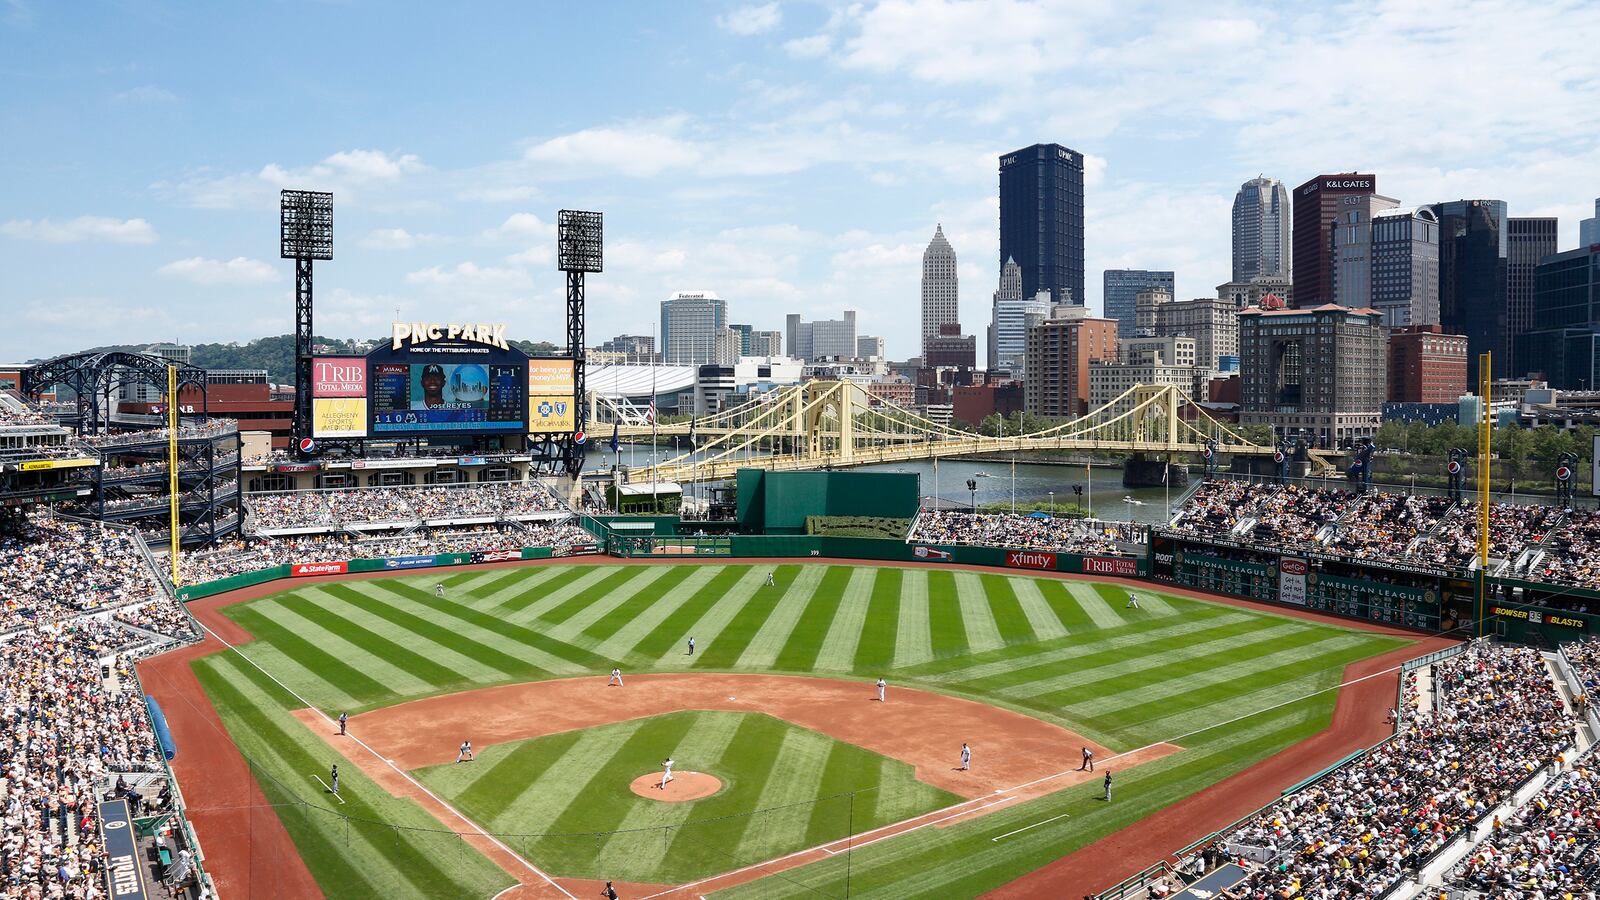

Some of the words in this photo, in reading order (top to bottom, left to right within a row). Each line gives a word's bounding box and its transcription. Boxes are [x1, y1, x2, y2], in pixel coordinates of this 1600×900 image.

[1058, 149, 1073, 162] UPMC
[1326, 180, 1341, 188] K&L
[1342, 180, 1370, 188] GATES
[392, 321, 442, 351] PNC
[446, 322, 510, 351] PARK
[315, 362, 362, 382] TRIB
[316, 382, 339, 392] TOTAL
[340, 383, 362, 392] MEDIA
[1159, 532, 1186, 540] CONNECT
[1254, 545, 1298, 556] PIRATES.COM
[1011, 552, 1051, 568] xfinity
[1114, 559, 1136, 568] TOTAL
[1155, 553, 1174, 562] ROOT
[1082, 557, 1113, 572] TRIB
[1184, 558, 1228, 570] NATIONAL
[1230, 566, 1266, 577] LEAGUE
[1282, 562, 1305, 572] GetGo
[1352, 558, 1448, 578] FACEBOOK.COM/PIRATES
[1463, 570, 1475, 579] 320
[1320, 580, 1375, 594] AMERICAN
[1378, 588, 1423, 602] LEAGUE
[1495, 607, 1528, 620] BOWSER
[1550, 616, 1584, 628] BLASTS
[111, 855, 138, 895] PIRATES
